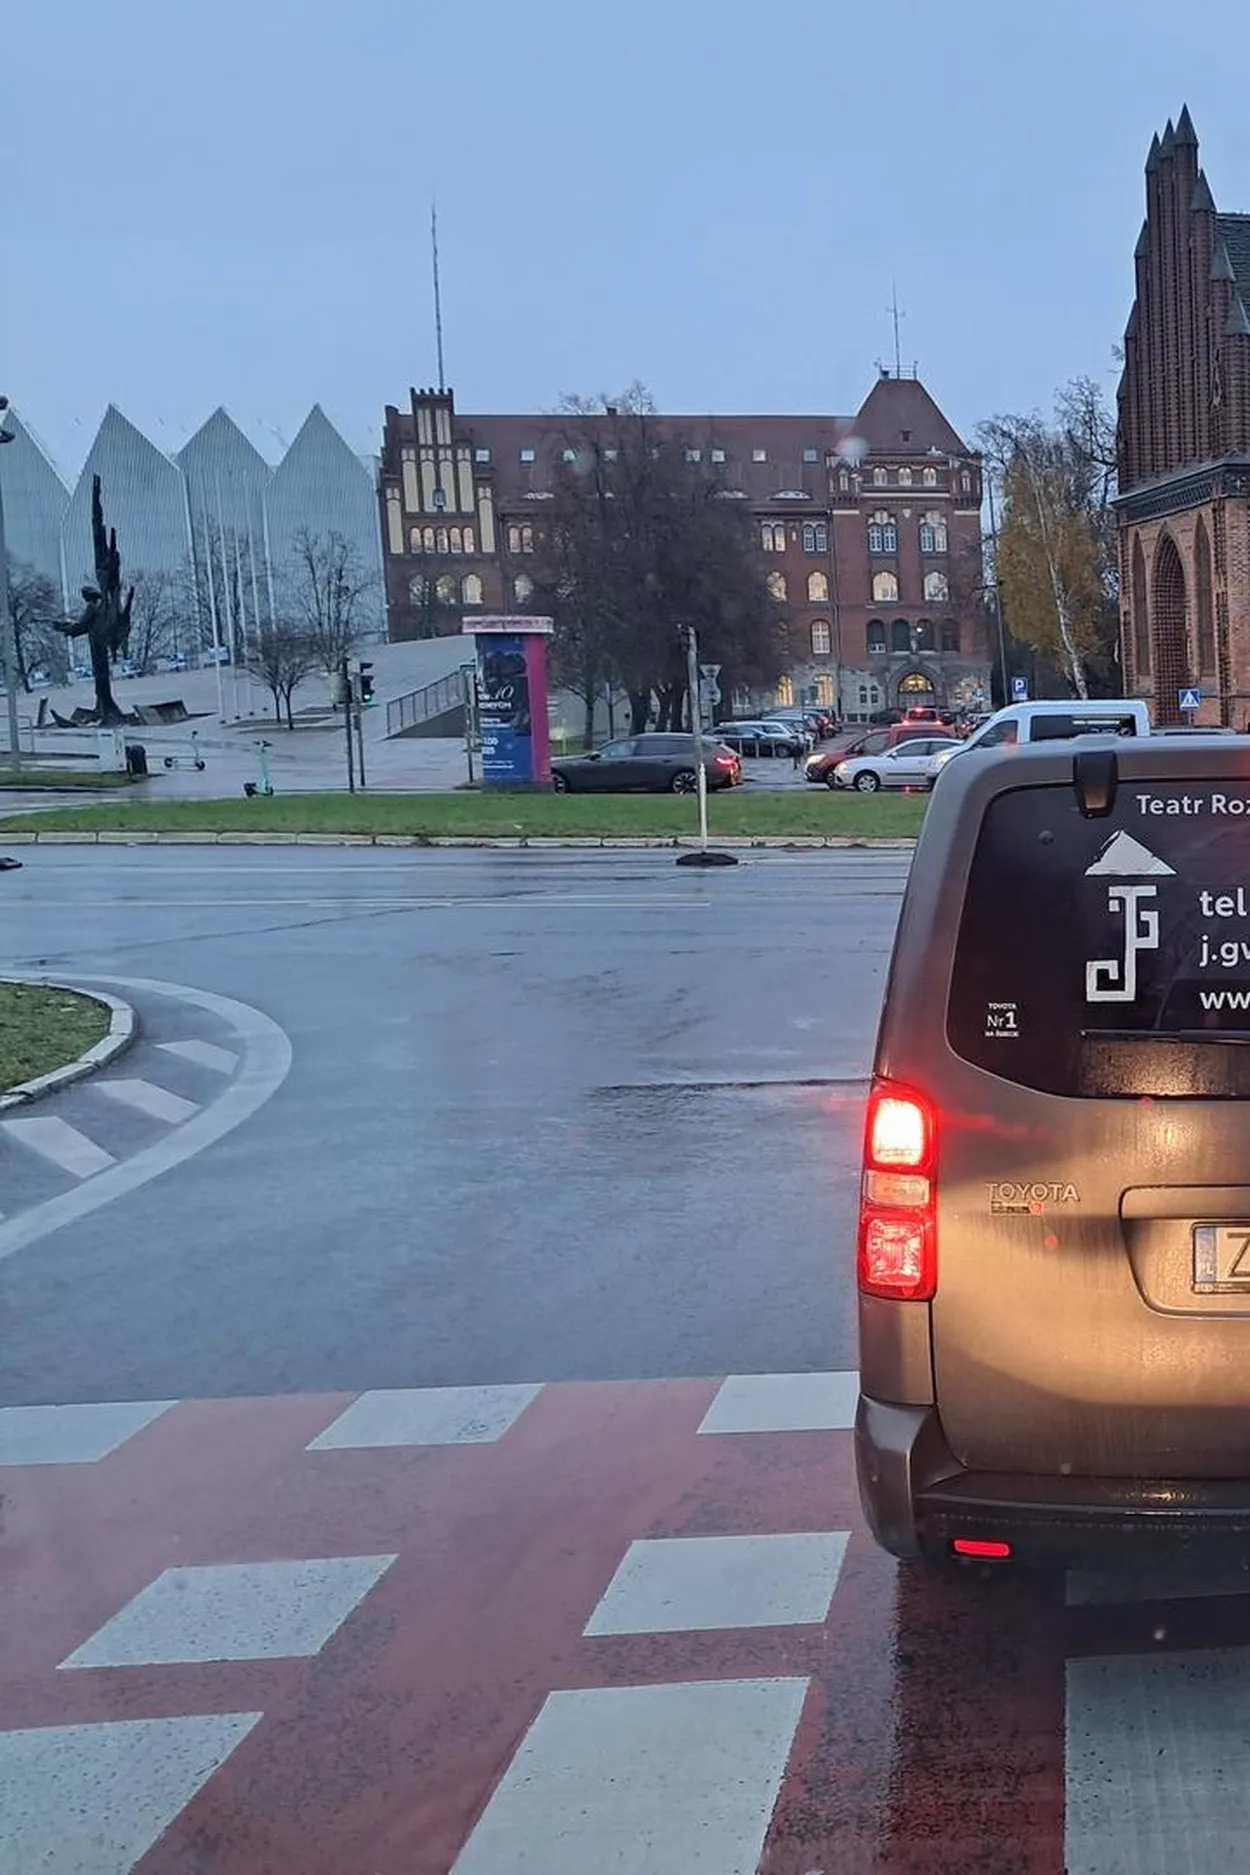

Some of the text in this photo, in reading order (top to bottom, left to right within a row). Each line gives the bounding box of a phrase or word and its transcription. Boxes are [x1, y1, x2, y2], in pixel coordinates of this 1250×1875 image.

[1015, 680, 1024, 692] P
[1136, 794, 1203, 815] Teatr
[986, 1182, 1080, 1202] TOYOTA
